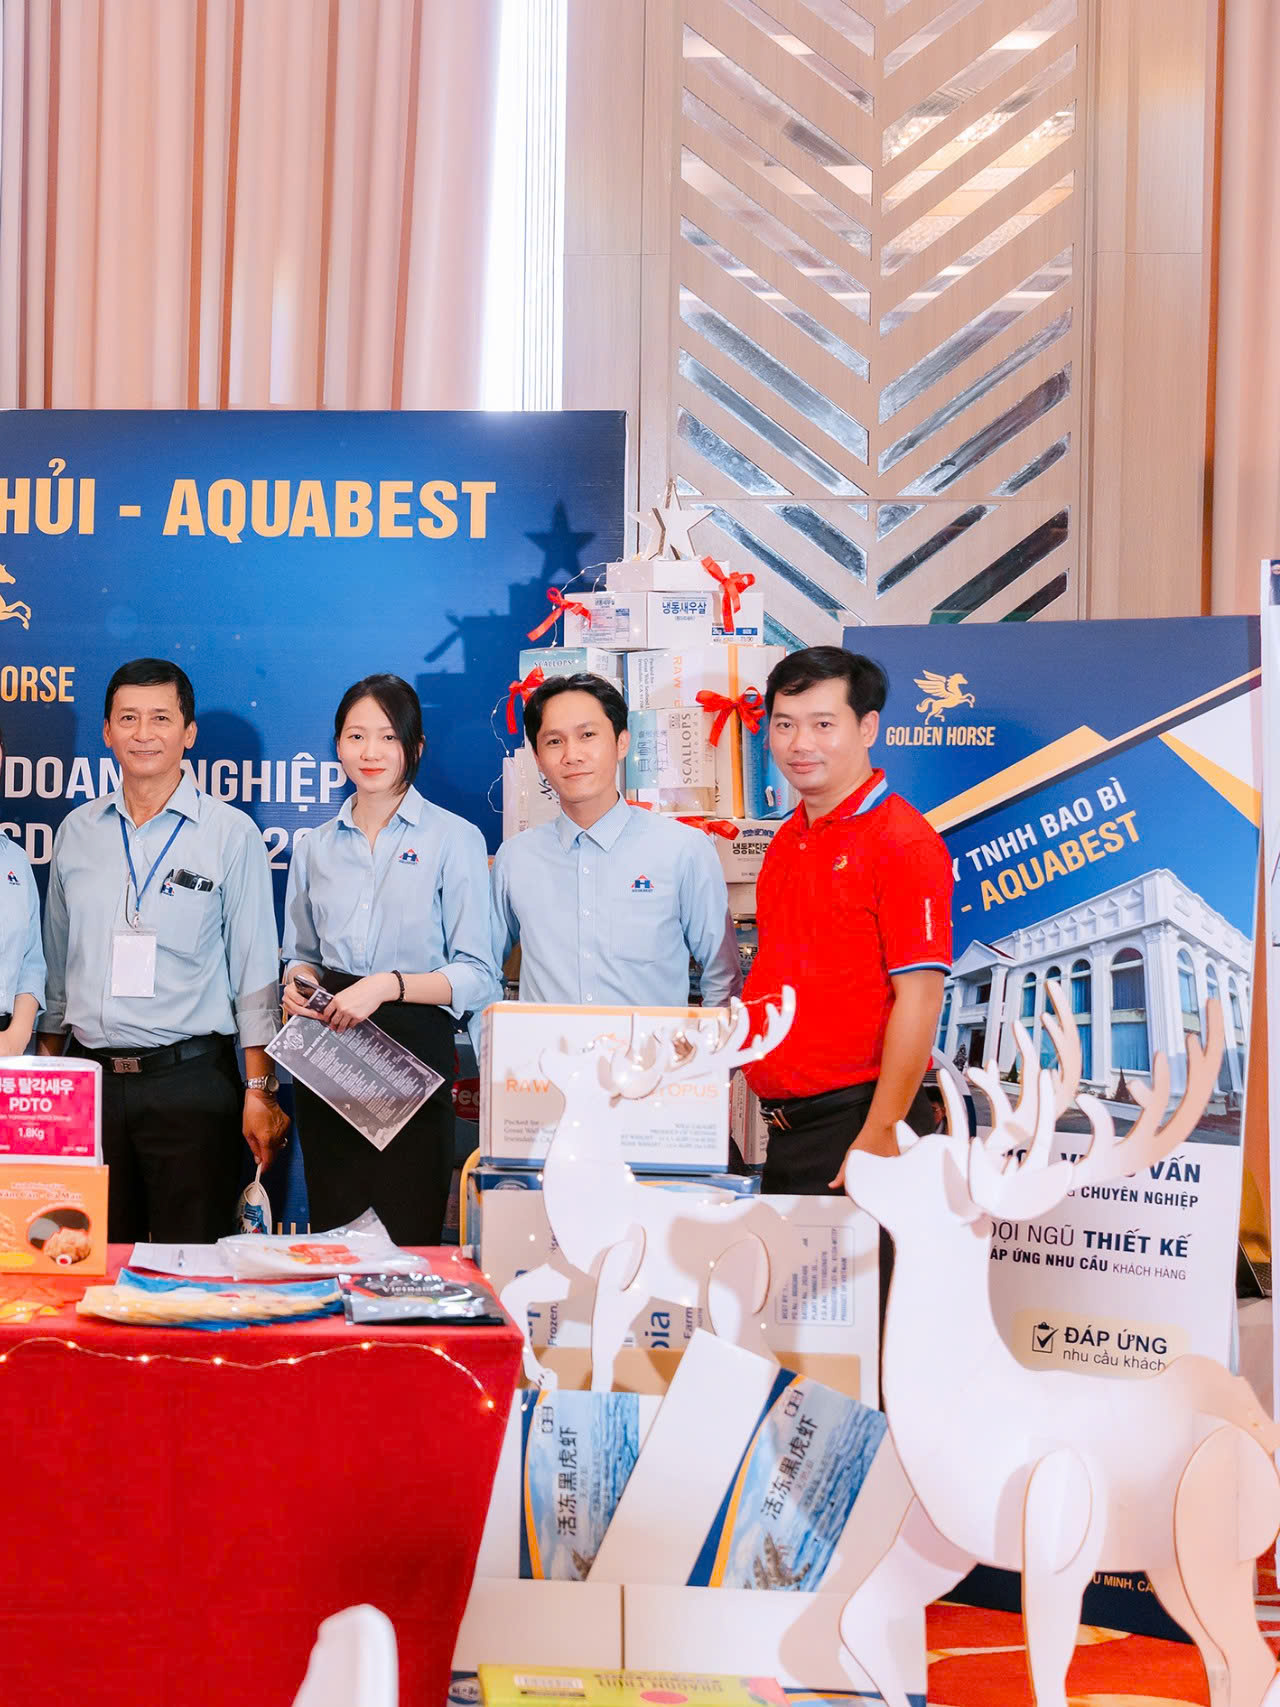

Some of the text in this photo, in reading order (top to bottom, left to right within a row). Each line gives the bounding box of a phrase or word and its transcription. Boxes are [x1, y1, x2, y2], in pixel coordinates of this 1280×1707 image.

[162, 478, 496, 544] AQUABEST
[681, 712, 692, 785] SCALLOPS
[885, 726, 996, 747] GOLDEN HORSE
[4, 756, 123, 799] DOAN
[966, 777, 1128, 874] TNHH BAO BÌ
[979, 810, 1143, 912] AQUABEST
[505, 1078, 552, 1094] RAW
[9, 1097, 52, 1112] PDTO
[18, 1127, 45, 1141] 1.8Kg
[1149, 1155, 1201, 1183] VẤN
[1081, 1186, 1199, 1210] CHUYÊN NGHIỆP
[1027, 1224, 1074, 1246] NGŨ
[1083, 1228, 1151, 1254] THIẾT
[1159, 1233, 1192, 1258] KẾ
[989, 1247, 1187, 1281] ÁP ỨNG NHU CẦU KHÁCH HÀNG
[547, 1303, 559, 1346] Frozen,
[1064, 1325, 1168, 1356] ĐÁP ỨNG
[1063, 1348, 1089, 1362] nhu
[1092, 1348, 1120, 1366] cầu
[557, 1426, 578, 1536] 活冻黑虎虾
[760, 1413, 818, 1520] 活冻黑虎虾
